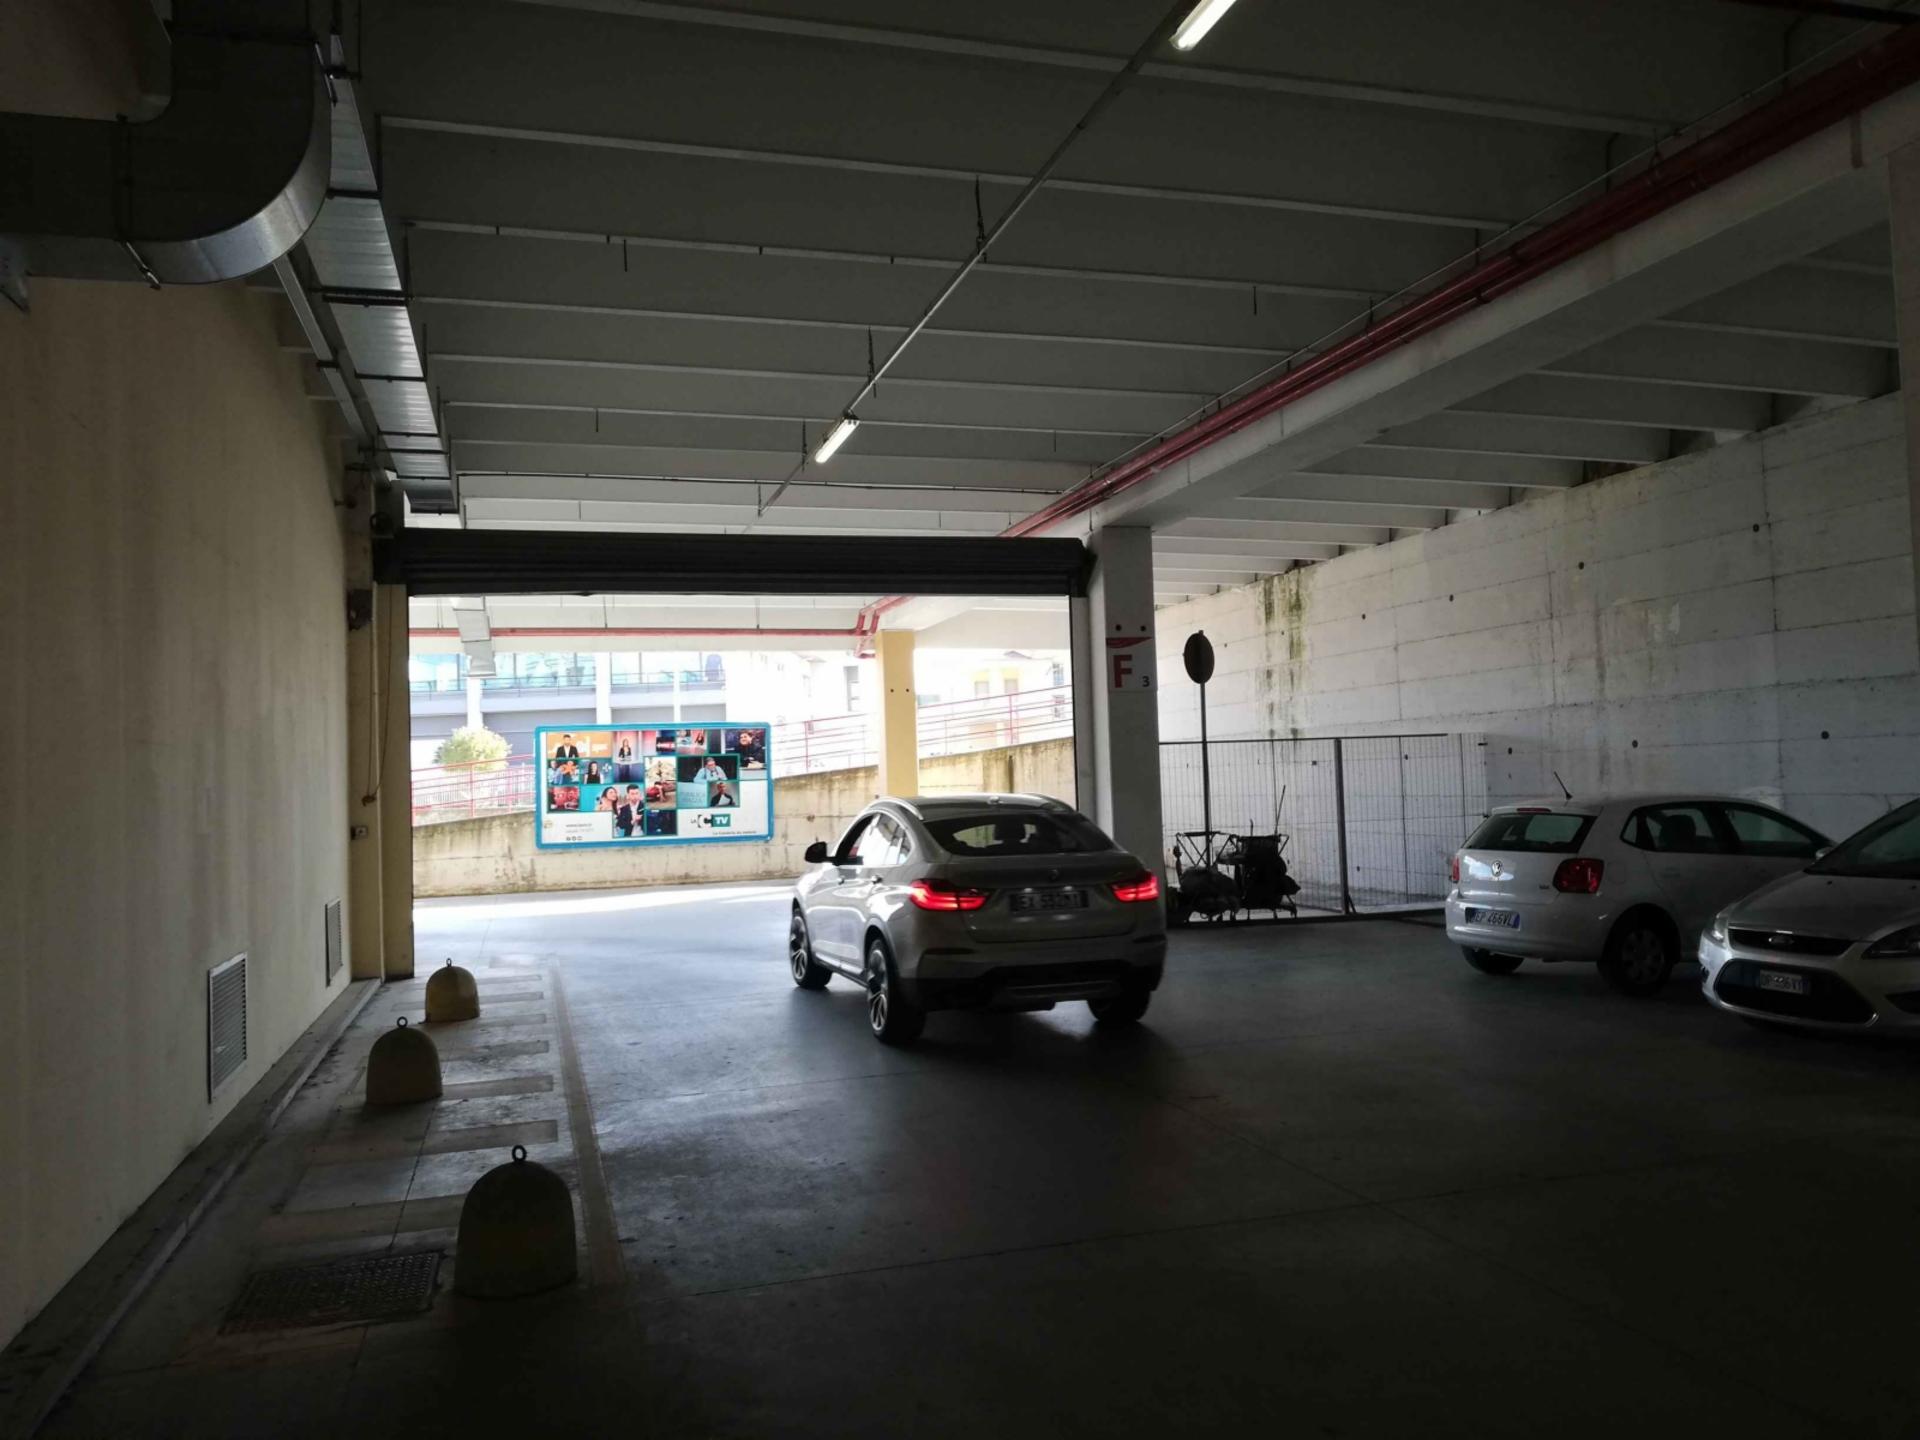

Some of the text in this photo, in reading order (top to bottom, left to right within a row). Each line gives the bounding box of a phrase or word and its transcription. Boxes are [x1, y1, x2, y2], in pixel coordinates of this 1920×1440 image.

[1113, 654, 1150, 688] F 3
[715, 816, 728, 825] TV
